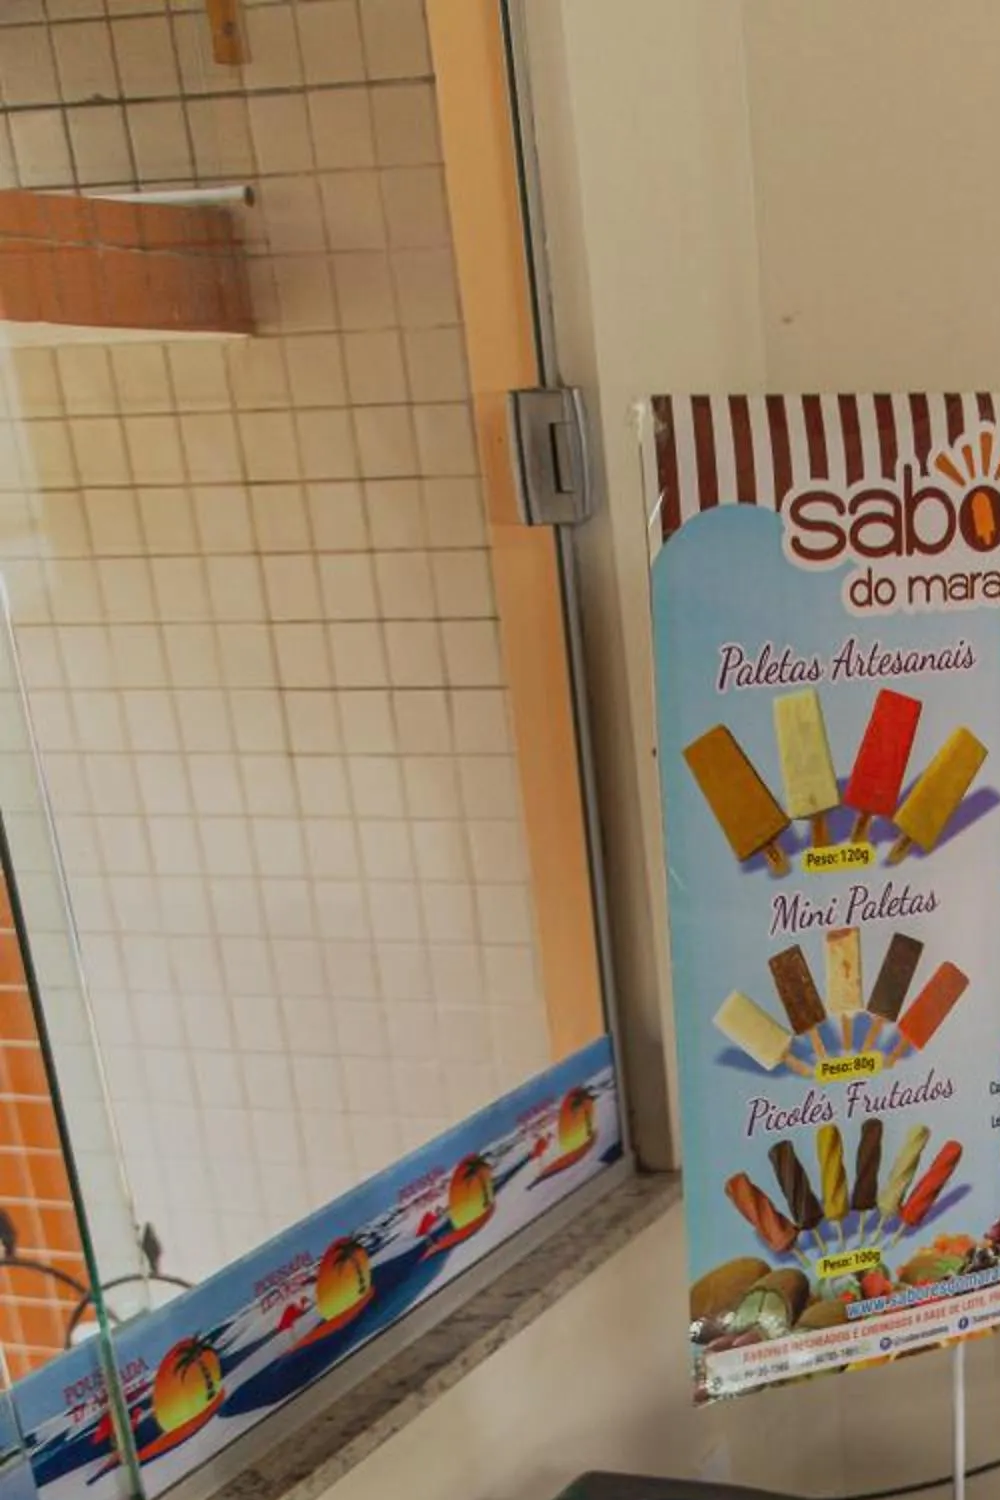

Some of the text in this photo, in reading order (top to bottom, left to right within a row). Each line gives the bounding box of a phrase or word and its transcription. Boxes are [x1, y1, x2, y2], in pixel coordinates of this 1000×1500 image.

[850, 567, 896, 607] do
[719, 639, 976, 689] Paletas Artesanais
[841, 848, 869, 864] 120g
[770, 882, 938, 936] Mini Paletas
[821, 1057, 875, 1077] Peso: 80g
[748, 1068, 954, 1136] Picolés Frutados
